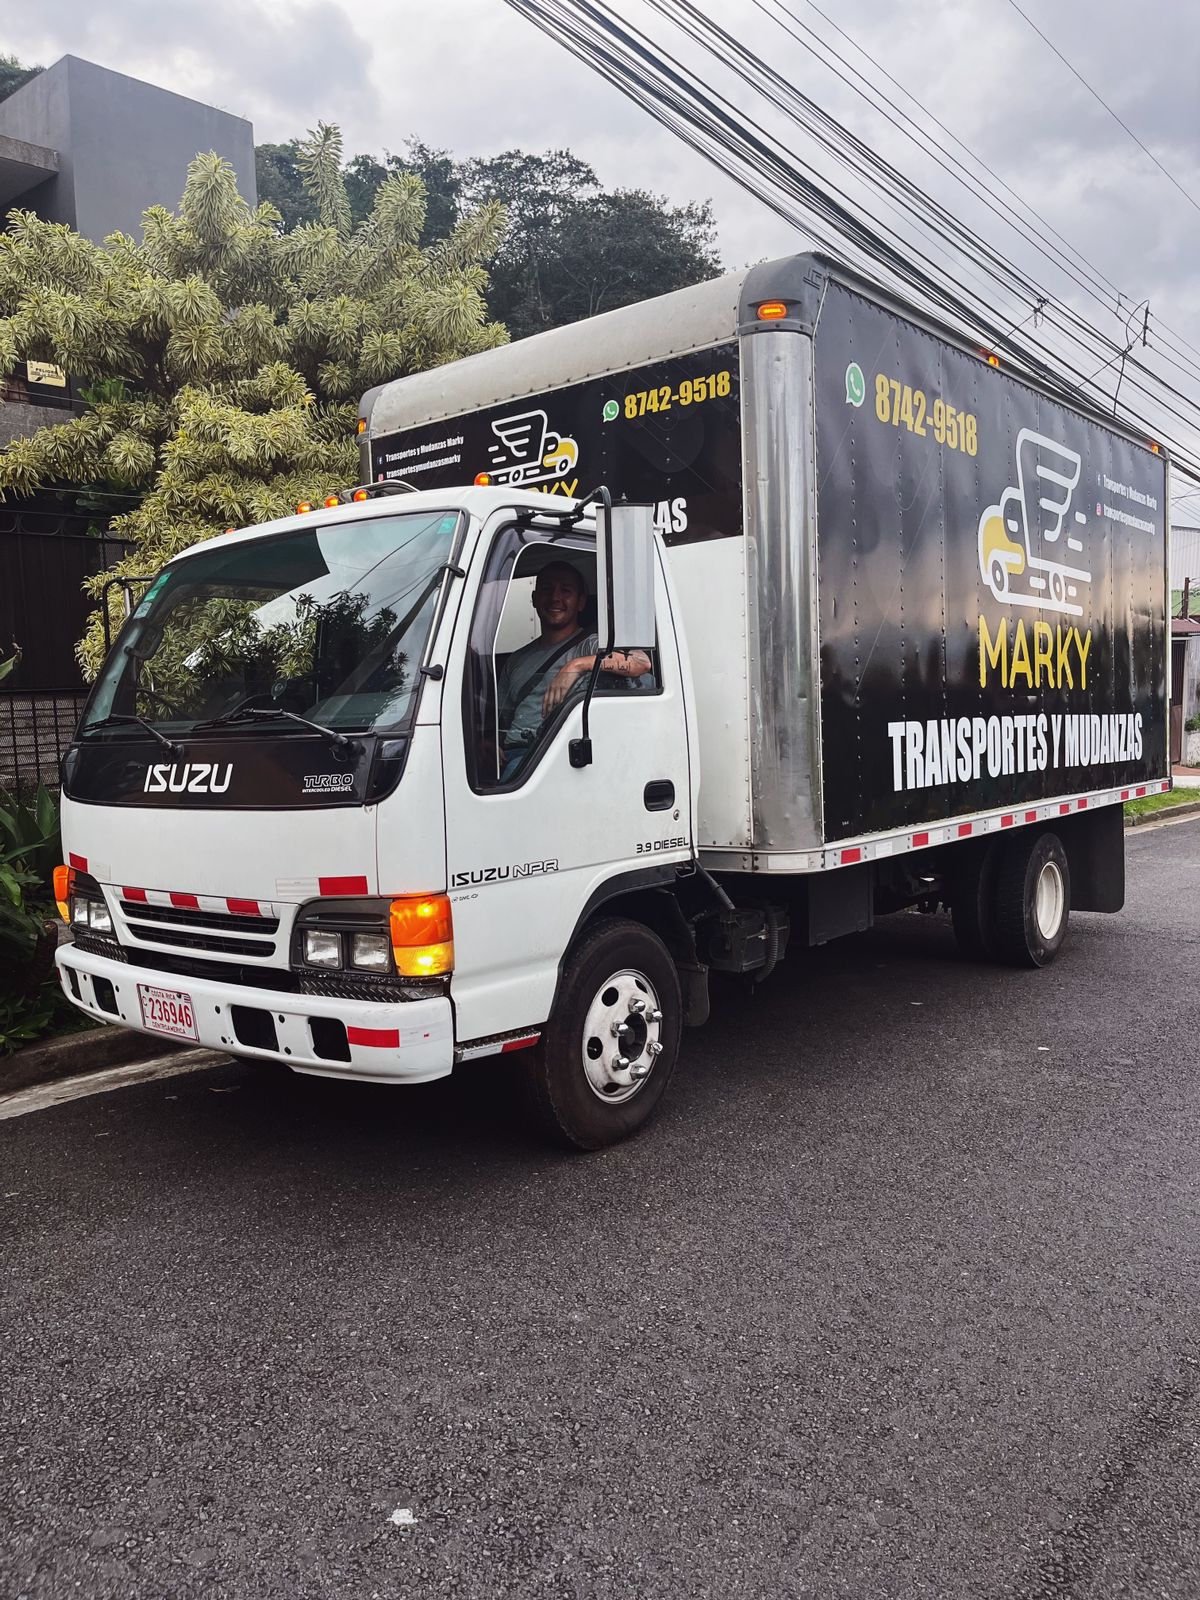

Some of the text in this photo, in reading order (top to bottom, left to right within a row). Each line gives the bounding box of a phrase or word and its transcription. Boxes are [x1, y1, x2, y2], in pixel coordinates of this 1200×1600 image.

[624, 371, 731, 419] 8742-9518
[875, 373, 978, 456] 8742-9518
[386, 447, 416, 463] Transportes
[420, 440, 447, 454] Mudanzas
[447, 436, 464, 447] Marky
[978, 613, 1092, 690] MARKY
[887, 712, 1143, 792] TRANSPORTES Y MUDANZAS
[143, 763, 234, 793] ISUZU
[303, 773, 354, 788] TURBO
[636, 837, 689, 854] 3.9 DIESEL
[451, 859, 559, 888] ISUZU NPR
[148, 997, 193, 1028] 236946
